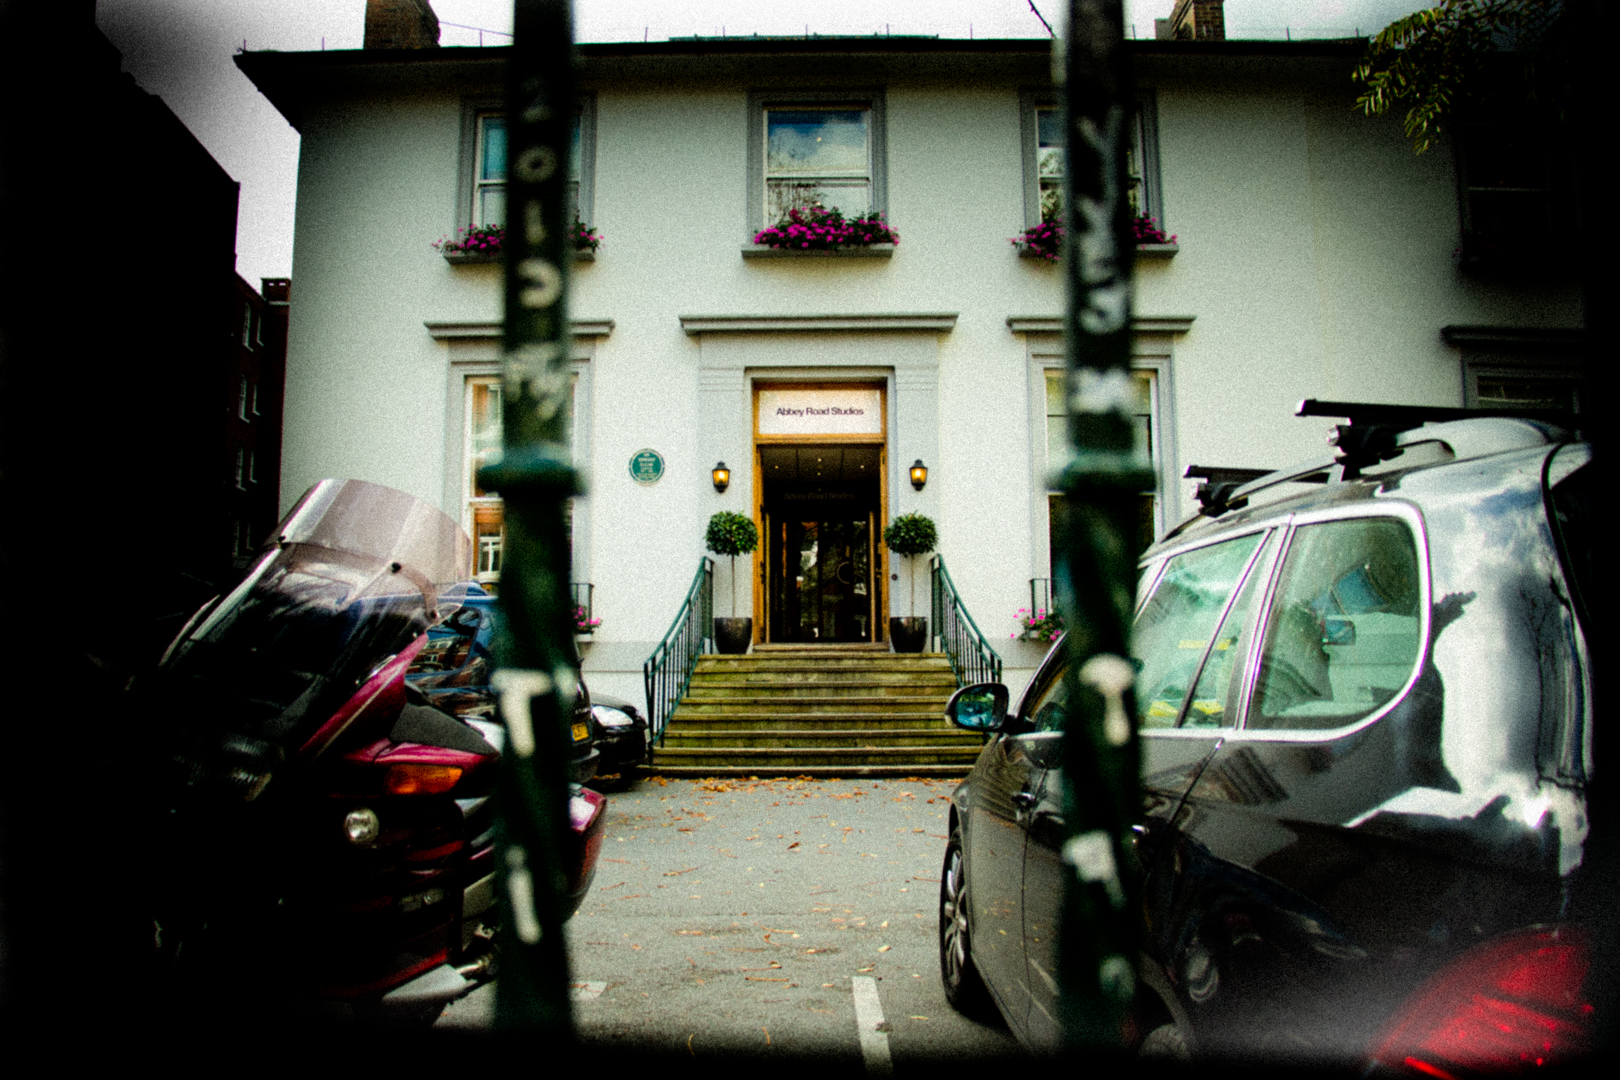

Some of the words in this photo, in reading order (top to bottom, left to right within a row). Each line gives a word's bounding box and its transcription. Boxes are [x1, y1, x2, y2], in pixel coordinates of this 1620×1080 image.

[776, 407, 804, 417] Abbey
[805, 407, 830, 415] Road
[831, 406, 864, 415] Studios
